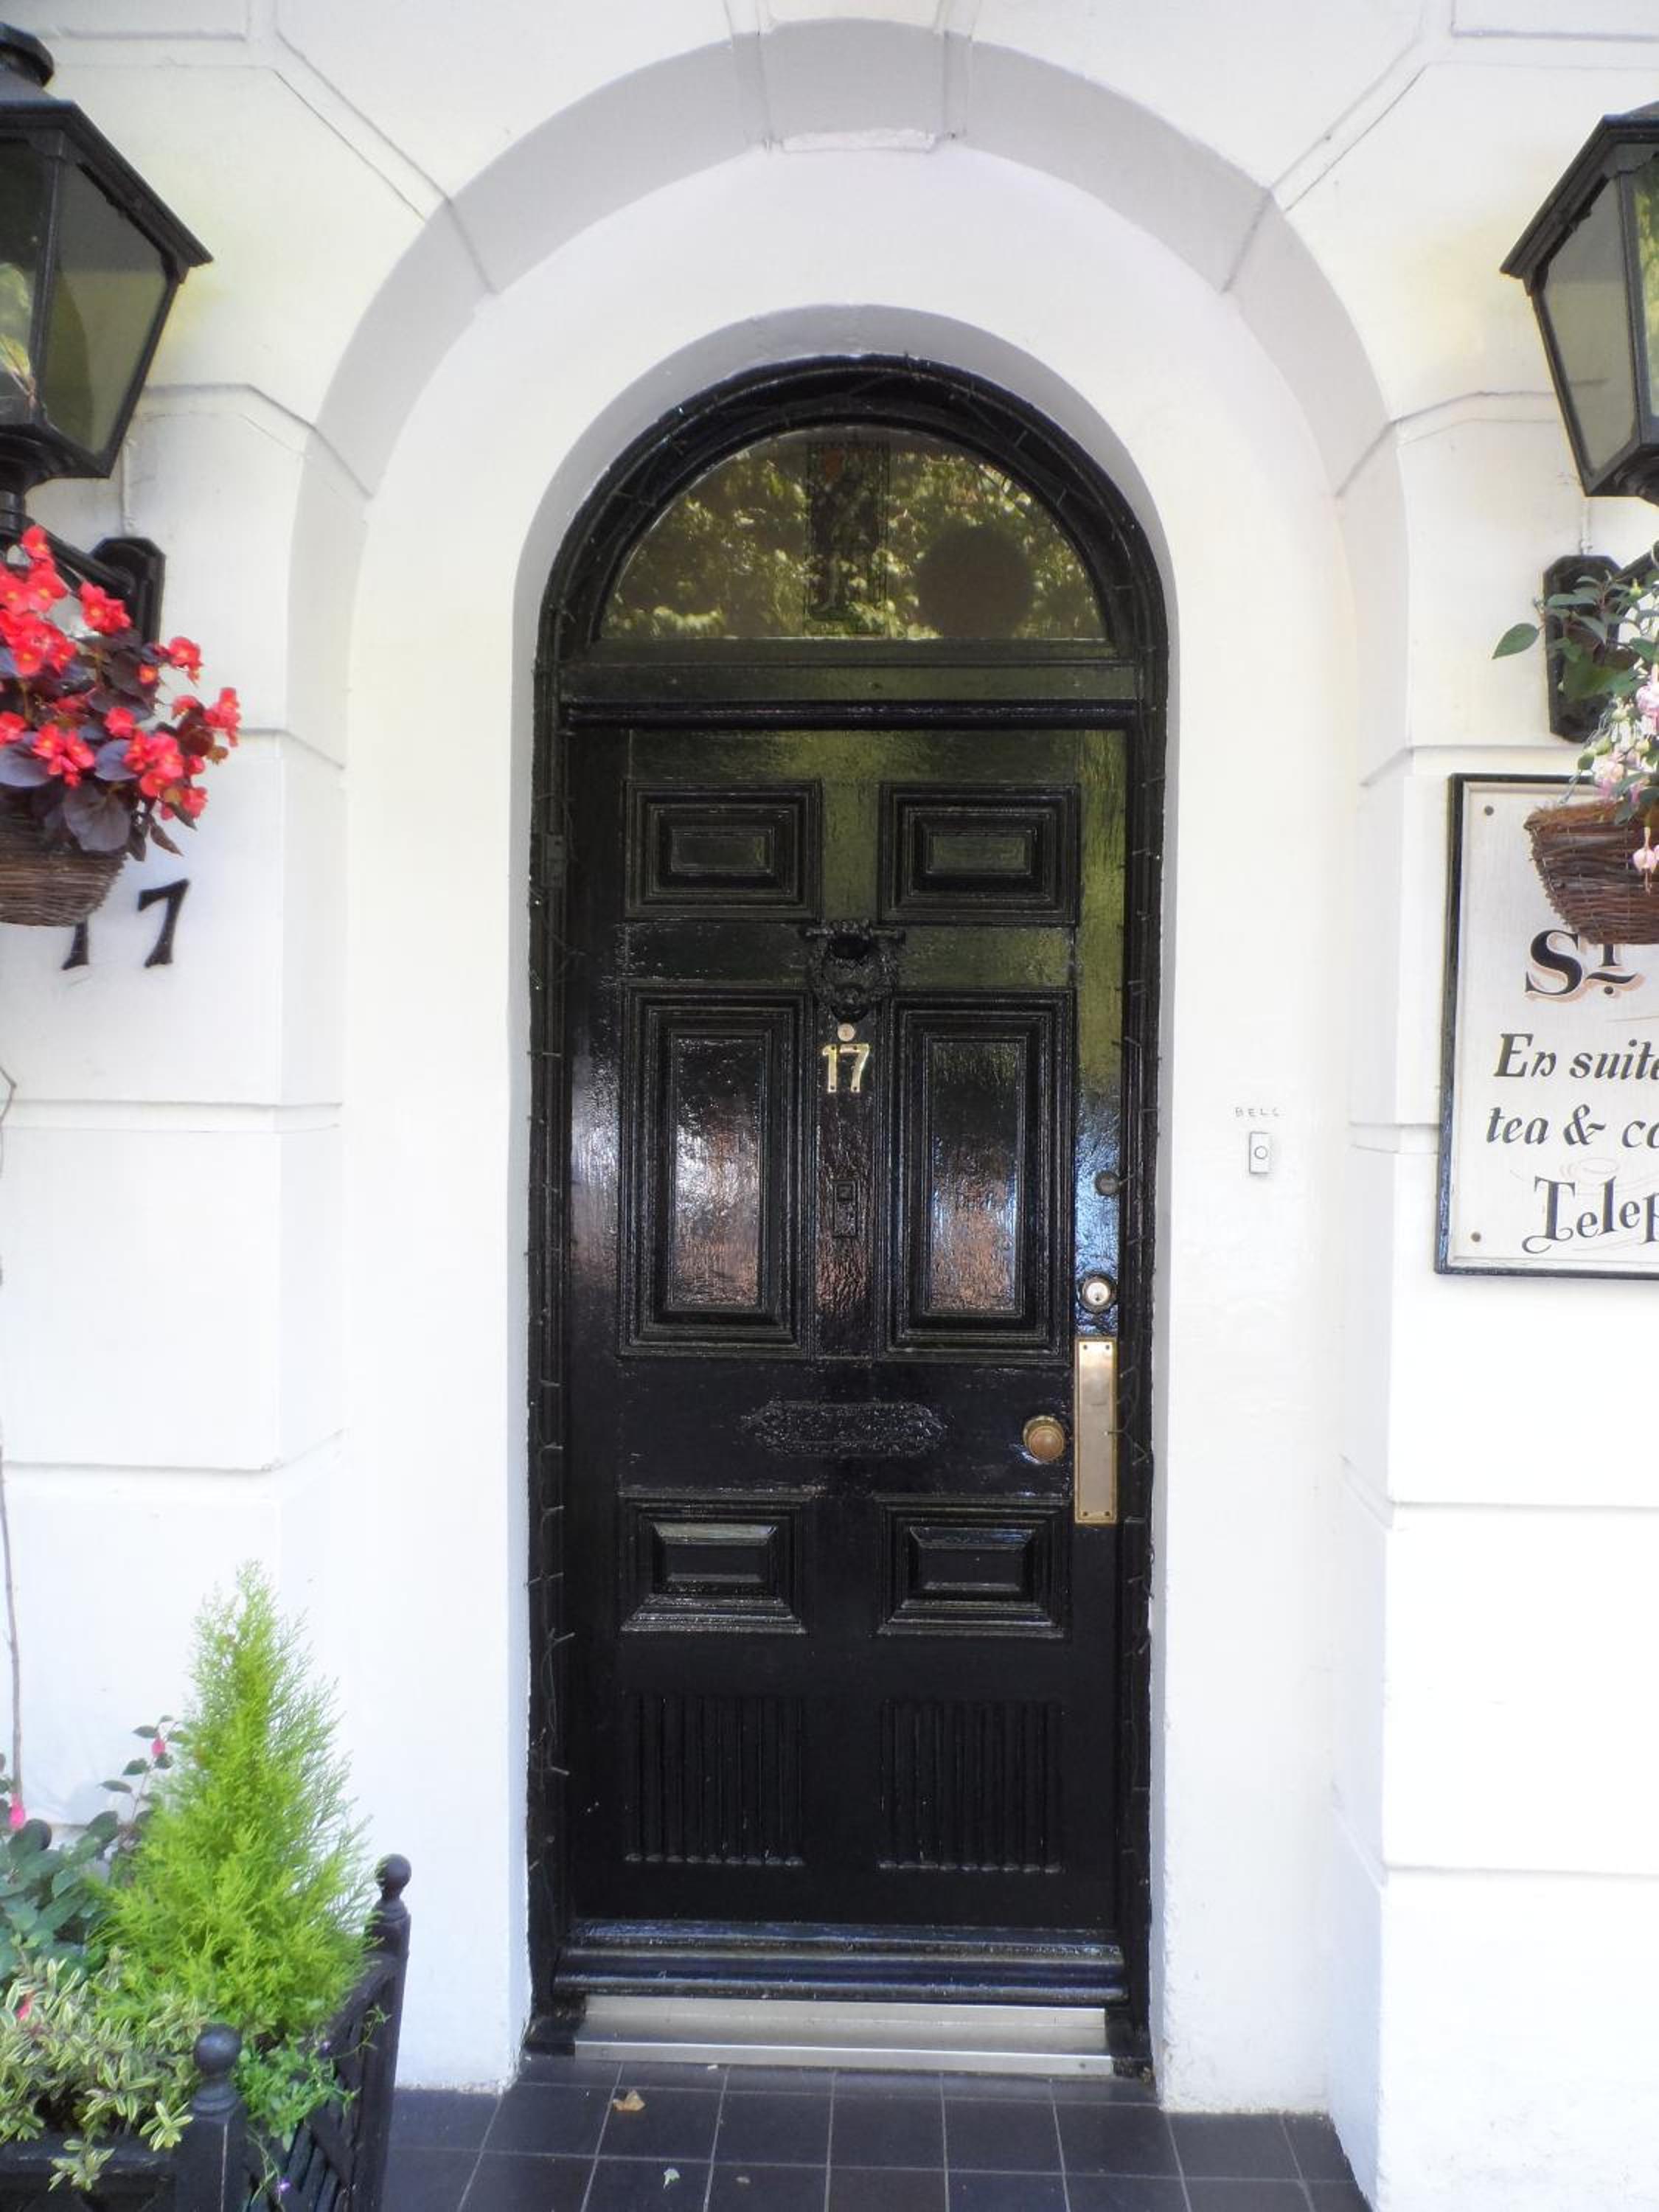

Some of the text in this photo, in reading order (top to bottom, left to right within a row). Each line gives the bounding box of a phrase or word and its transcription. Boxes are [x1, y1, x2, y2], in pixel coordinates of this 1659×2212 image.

[822, 1043, 870, 1093] 17
[1493, 1033, 1557, 1077] En
[1234, 1107, 1281, 1118] BELL
[1486, 1107, 1550, 1144] tea
[1563, 1104, 1607, 1146] &
